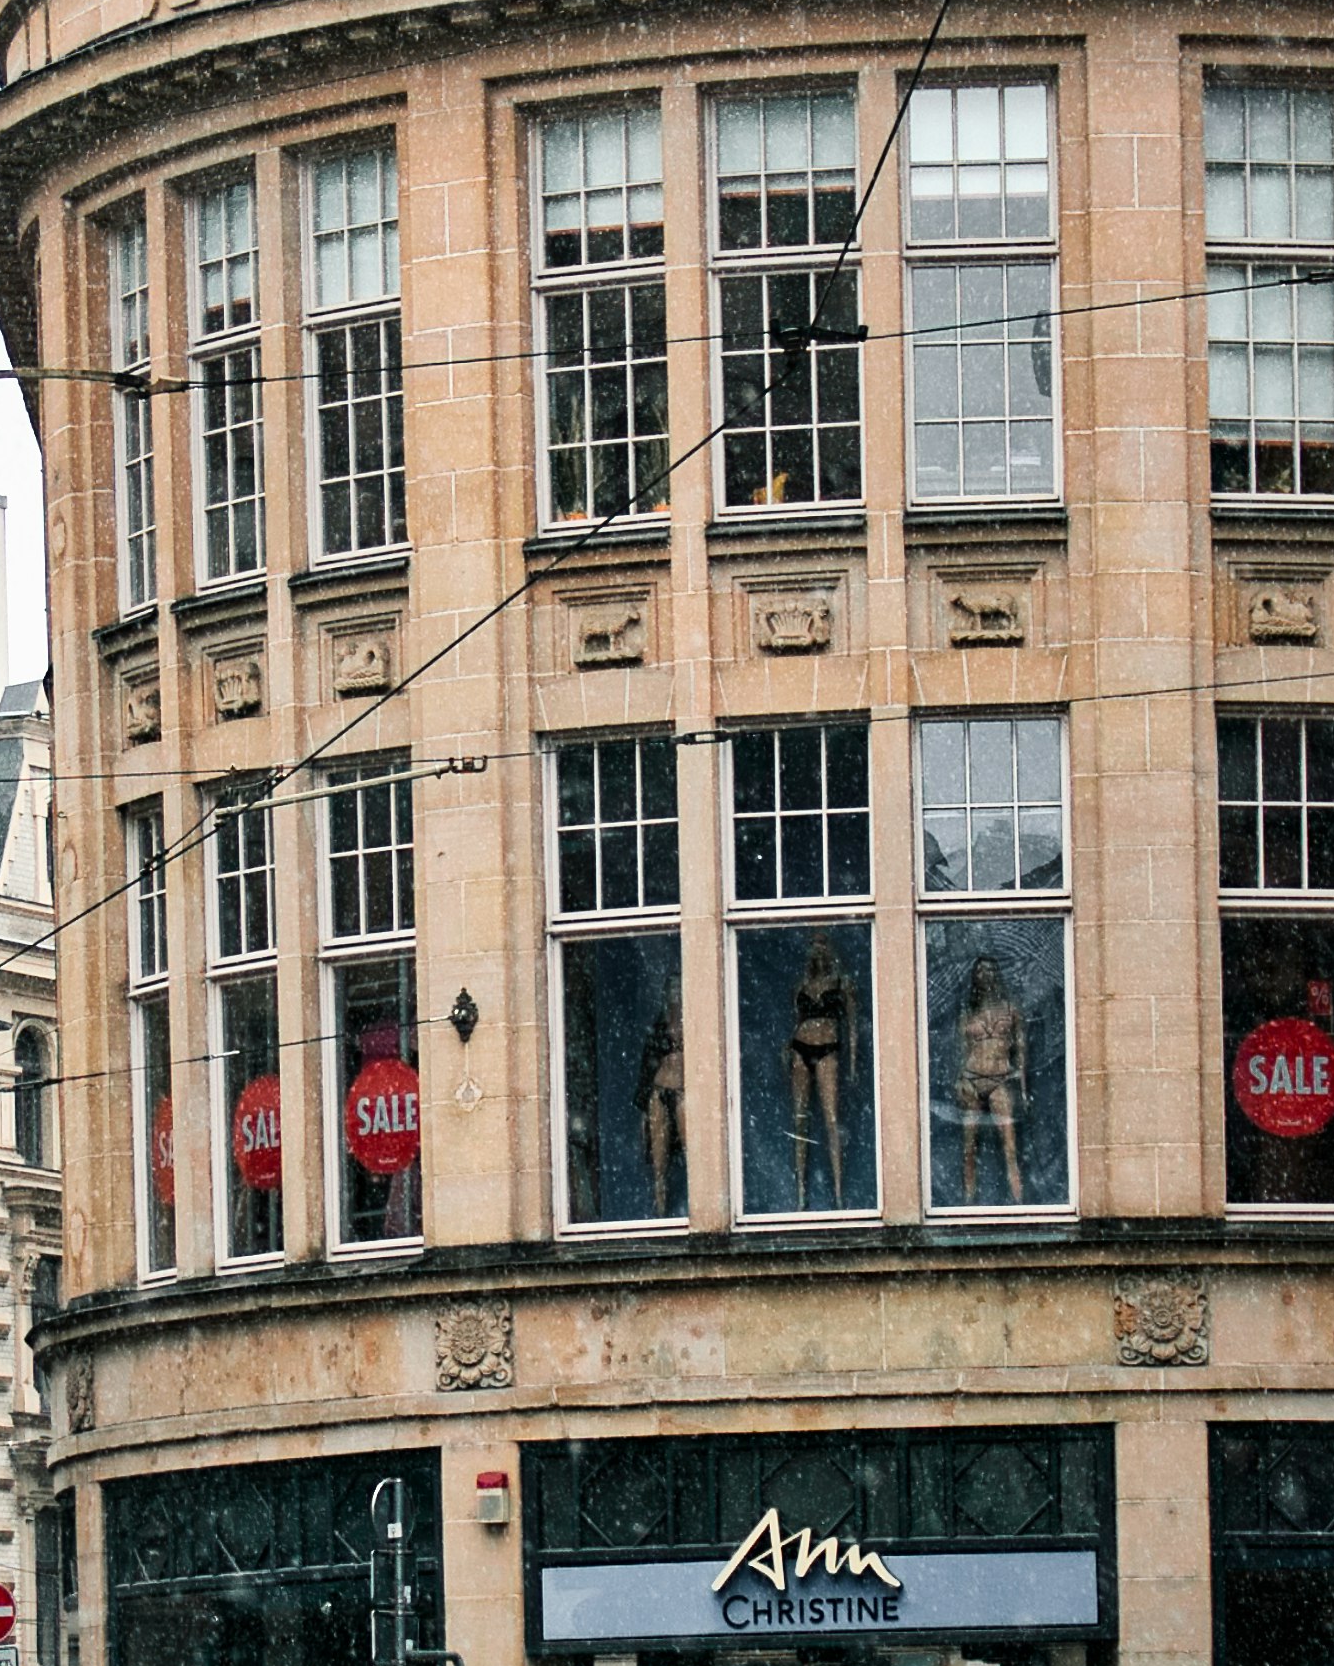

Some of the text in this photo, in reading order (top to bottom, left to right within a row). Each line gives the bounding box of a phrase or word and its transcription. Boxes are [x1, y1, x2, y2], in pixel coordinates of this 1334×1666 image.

[1248, 1055, 1331, 1096] SALE
[356, 1092, 417, 1136] SALE
[711, 1507, 901, 1591] Ann
